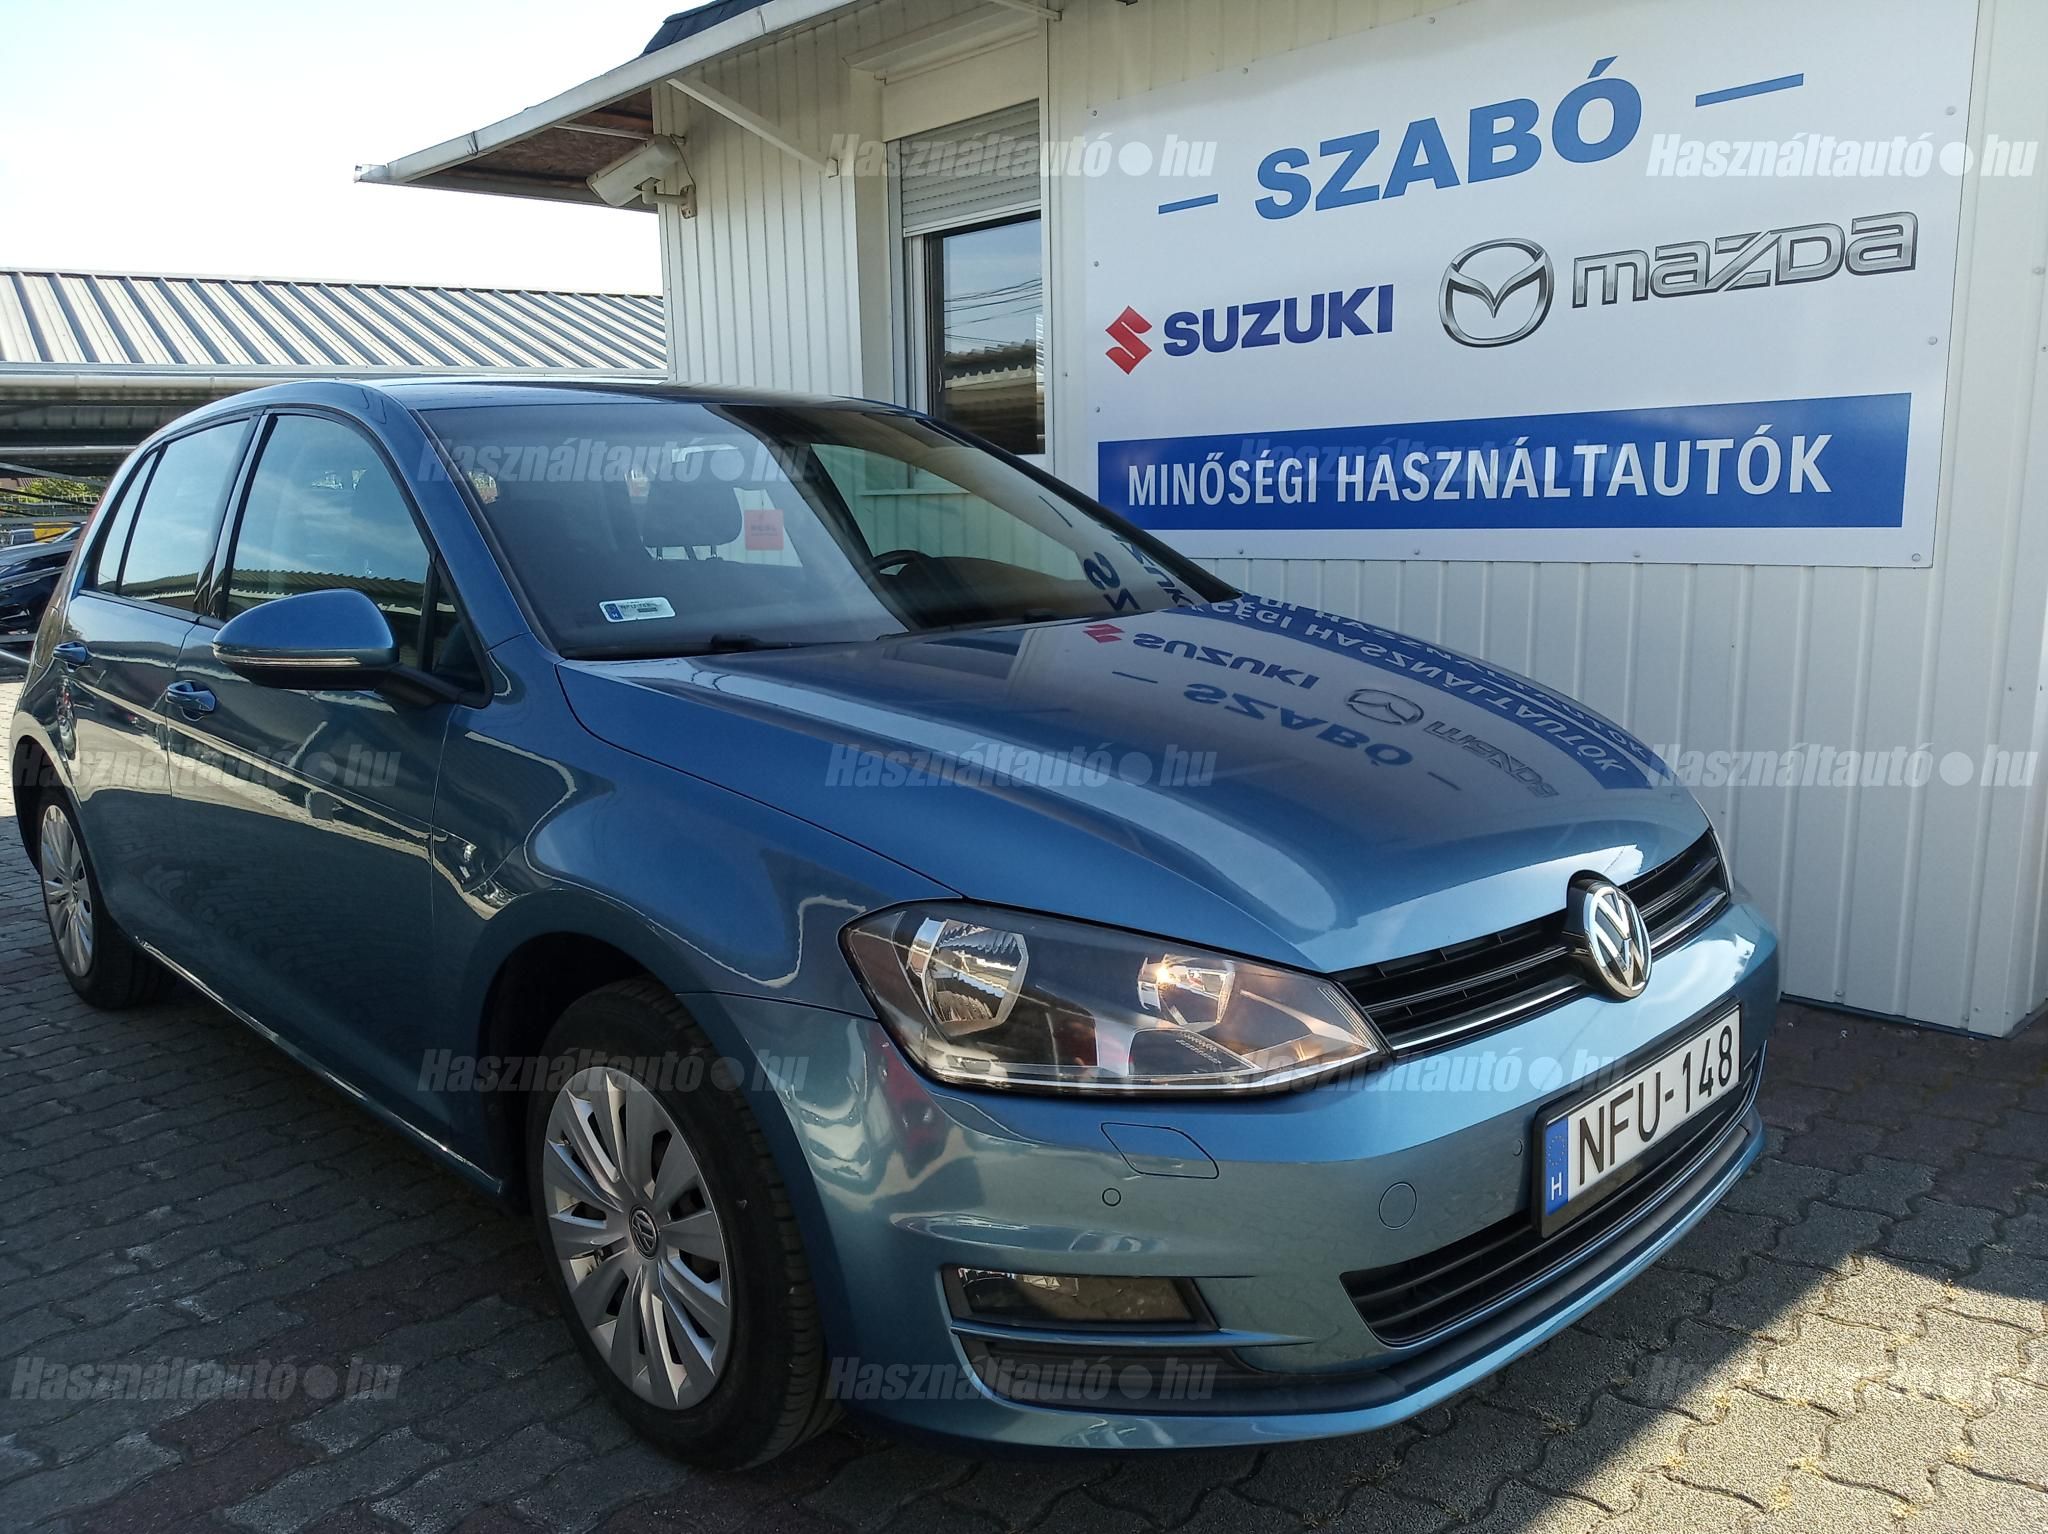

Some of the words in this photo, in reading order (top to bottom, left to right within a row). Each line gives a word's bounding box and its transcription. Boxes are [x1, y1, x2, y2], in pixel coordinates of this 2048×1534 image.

[1255, 56, 1642, 220] SZABÓ
[1163, 284, 1394, 357] SUZUKI
[1128, 449, 1317, 506] MINŐSÉGI
[1337, 424, 1832, 503] HASZNÁLTAUTÓK
[1579, 1025, 1733, 1186] NFU-148
[1551, 1172, 1563, 1201] H
